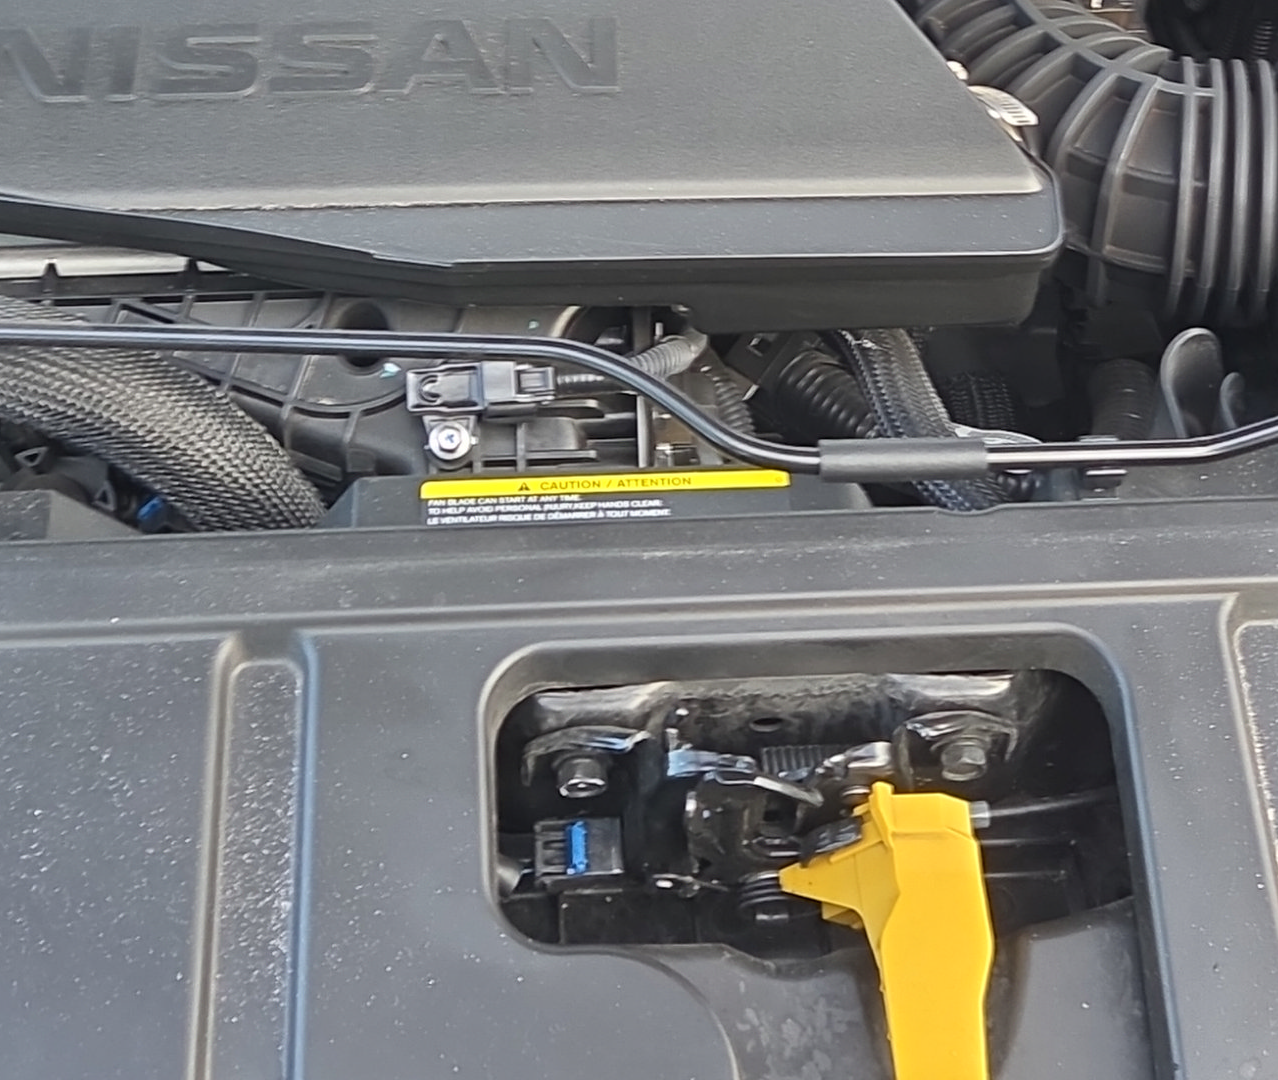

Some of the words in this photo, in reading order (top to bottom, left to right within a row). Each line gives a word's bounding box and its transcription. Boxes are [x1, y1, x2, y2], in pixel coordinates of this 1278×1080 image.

[539, 480, 601, 491] CAUTION
[617, 475, 692, 488] ATTENTION
[427, 499, 446, 507] FAN
[447, 497, 477, 506] BLADE
[478, 497, 497, 505] CAN
[499, 496, 526, 504] START
[527, 495, 539, 503] AT
[428, 507, 440, 516] TO
[442, 506, 466, 515] HELP
[466, 505, 494, 514] AVOID
[495, 504, 542, 513] PERSONAL
[598, 500, 630, 508] HANDS
[426, 517, 439, 526] LE
[440, 514, 498, 525] VENTILATEUR
[499, 513, 532, 522] RISQUE
[533, 512, 546, 521] DE
[547, 510, 597, 520] DÉMARRER
[606, 509, 629, 518] TOUT
